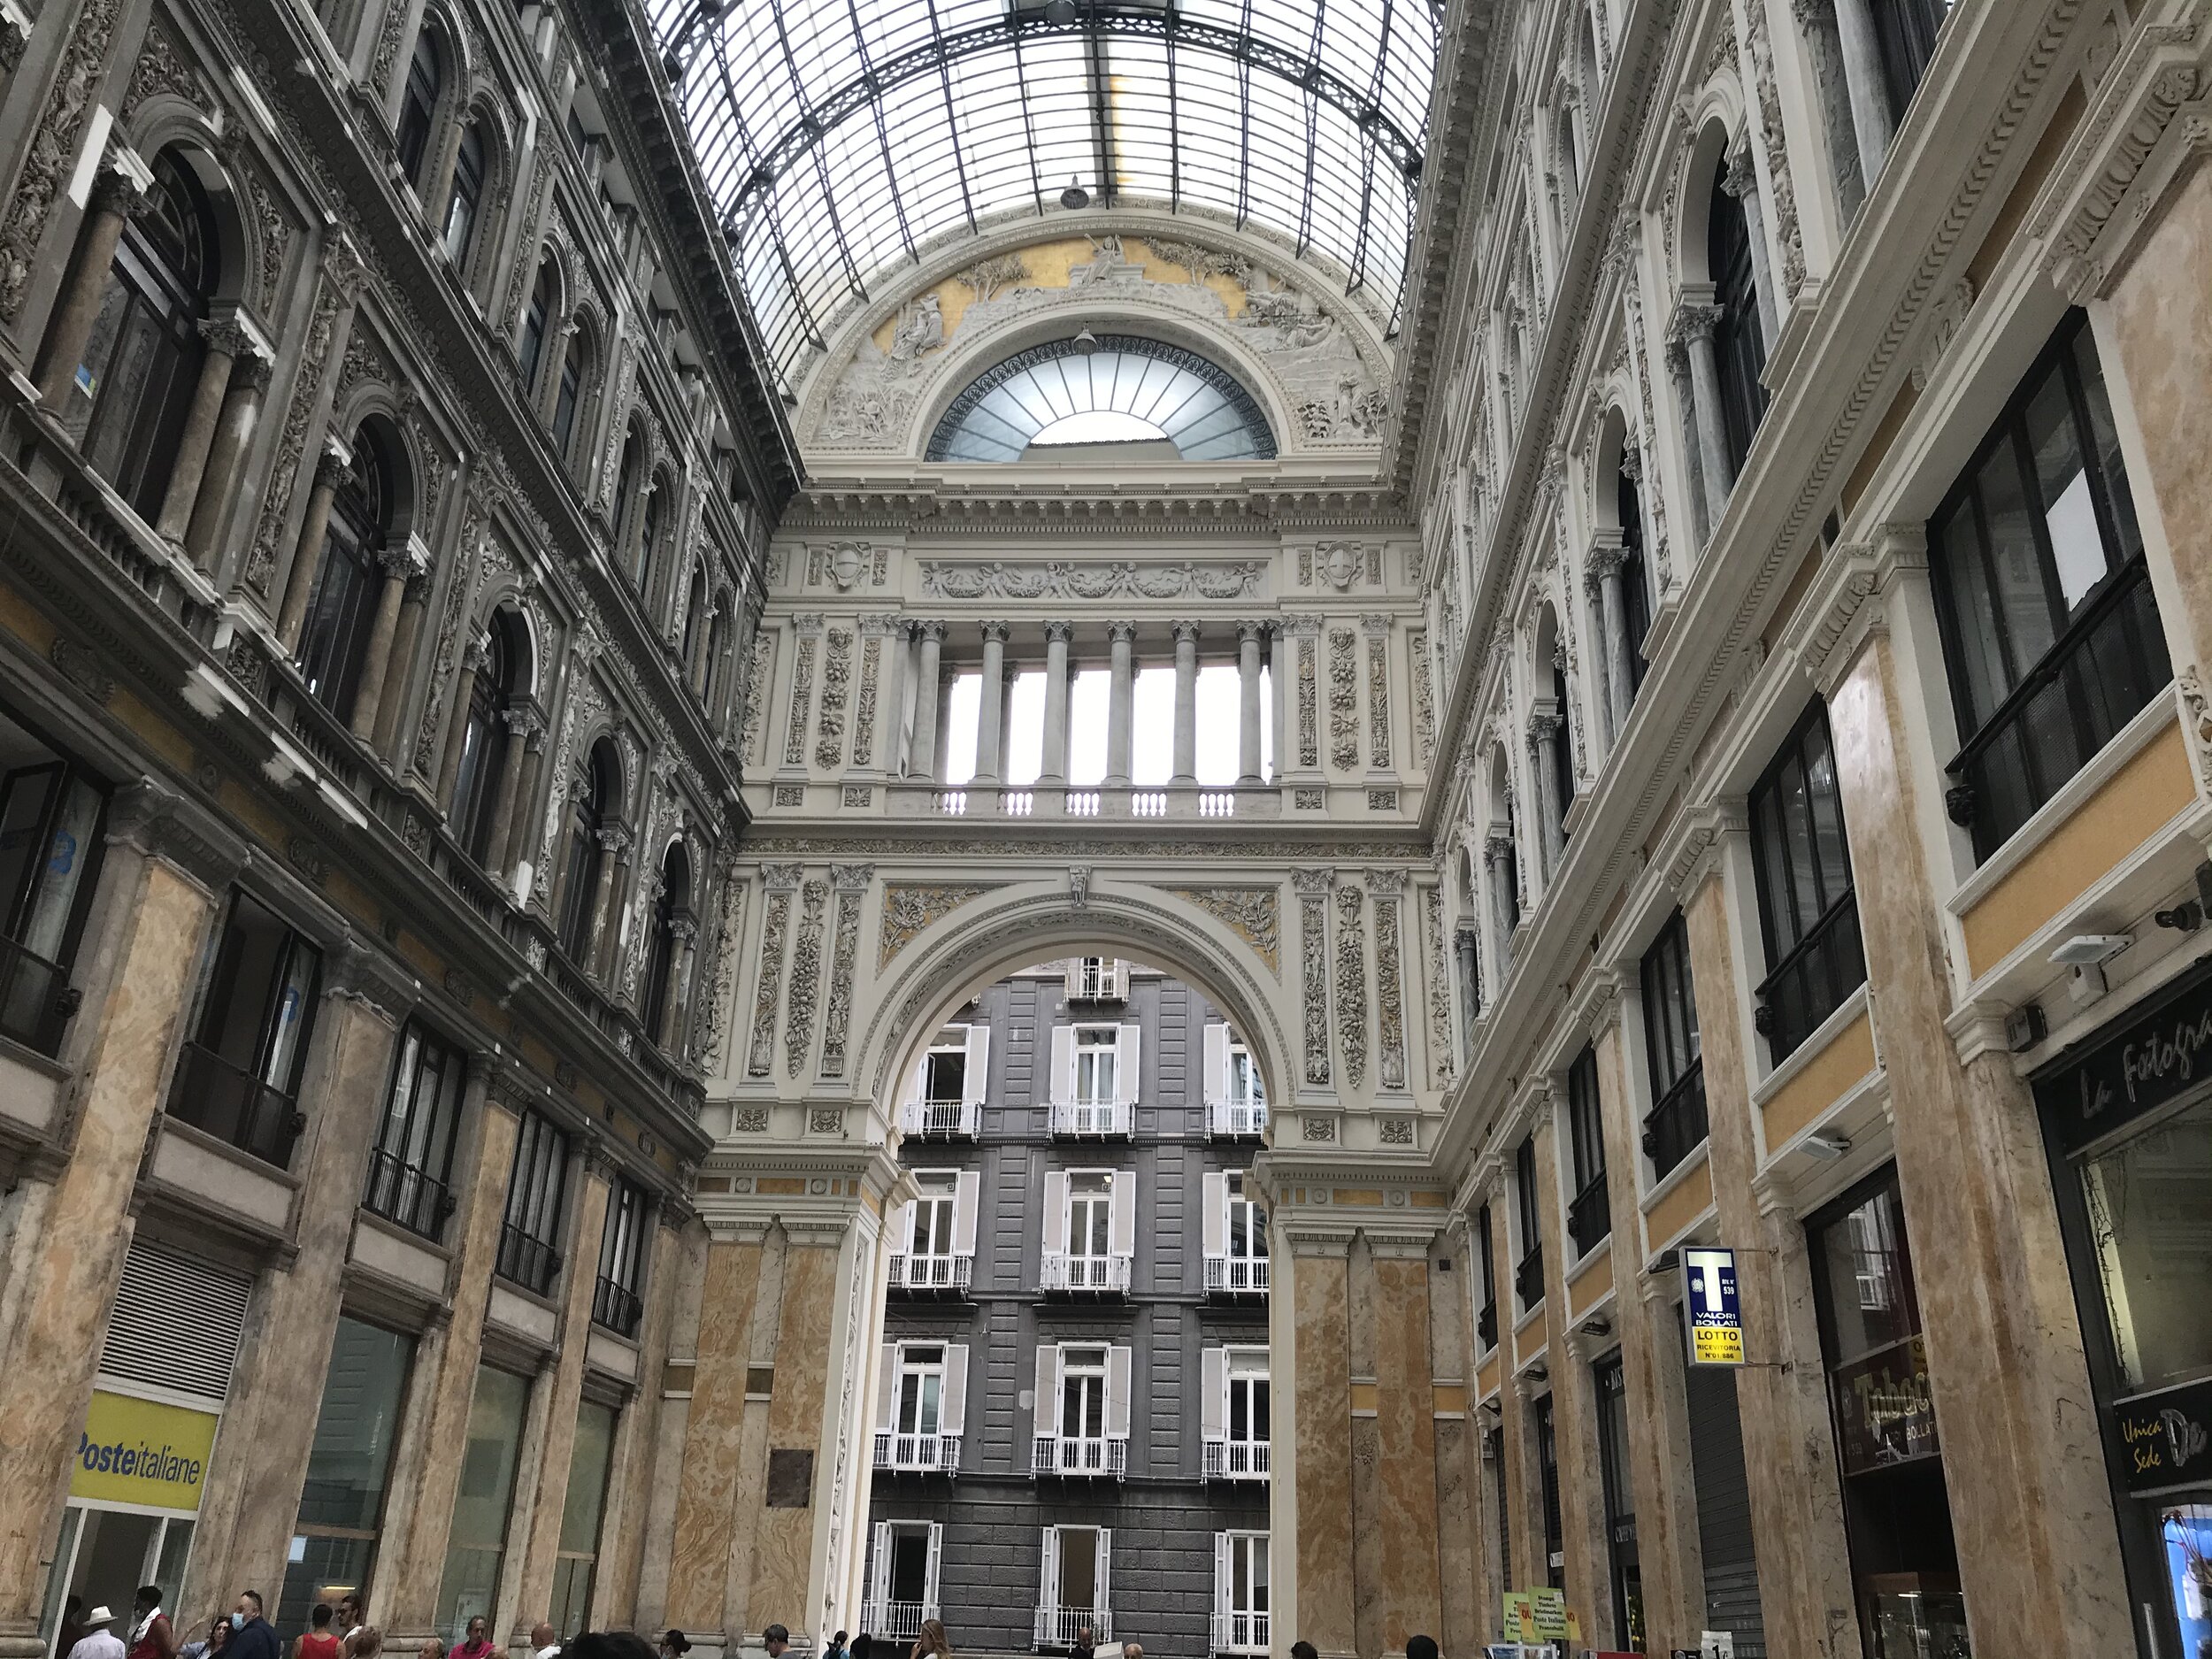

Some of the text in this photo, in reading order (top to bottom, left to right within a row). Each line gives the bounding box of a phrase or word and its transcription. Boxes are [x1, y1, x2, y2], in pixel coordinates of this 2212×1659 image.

[1687, 1251, 1732, 1311] T
[1697, 1331, 1738, 1340] LOTTO
[2123, 1417, 2162, 1443] Unica
[2133, 1443, 2162, 1473] Sede
